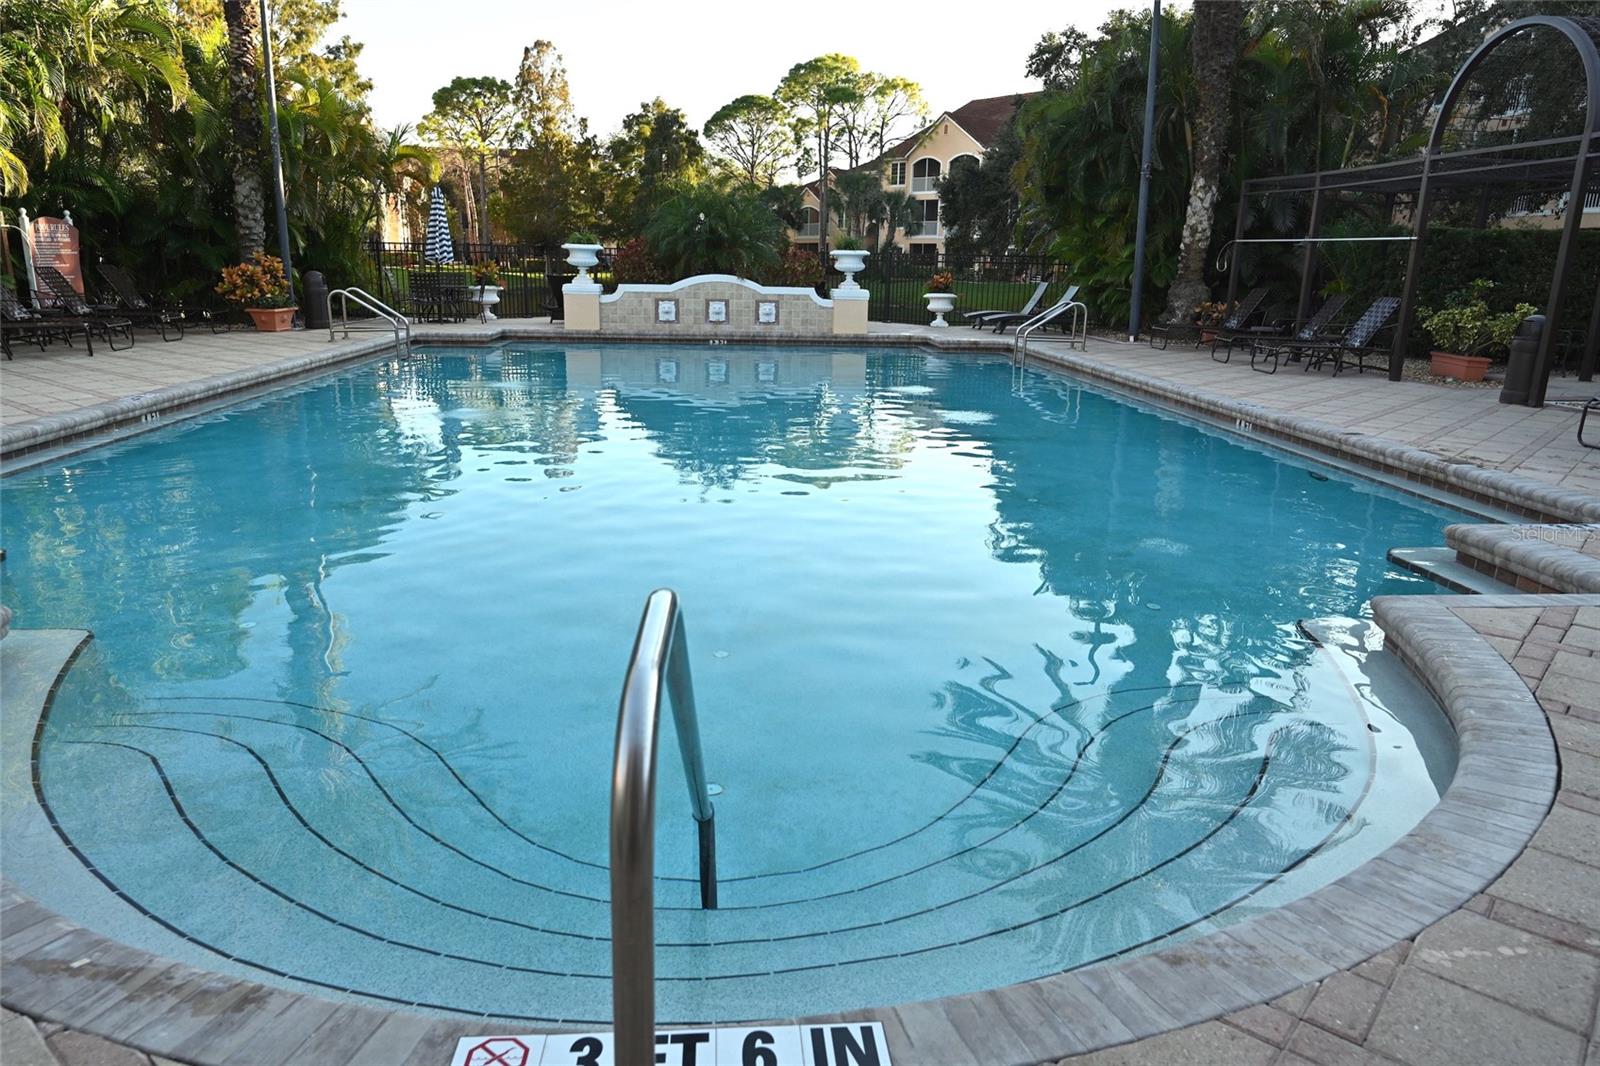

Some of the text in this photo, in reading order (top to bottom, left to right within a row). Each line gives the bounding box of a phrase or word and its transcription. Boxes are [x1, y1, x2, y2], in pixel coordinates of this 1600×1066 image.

[569, 1036, 604, 1066] 3
[742, 1030, 778, 1066] 6
[810, 1025, 881, 1066] IN
